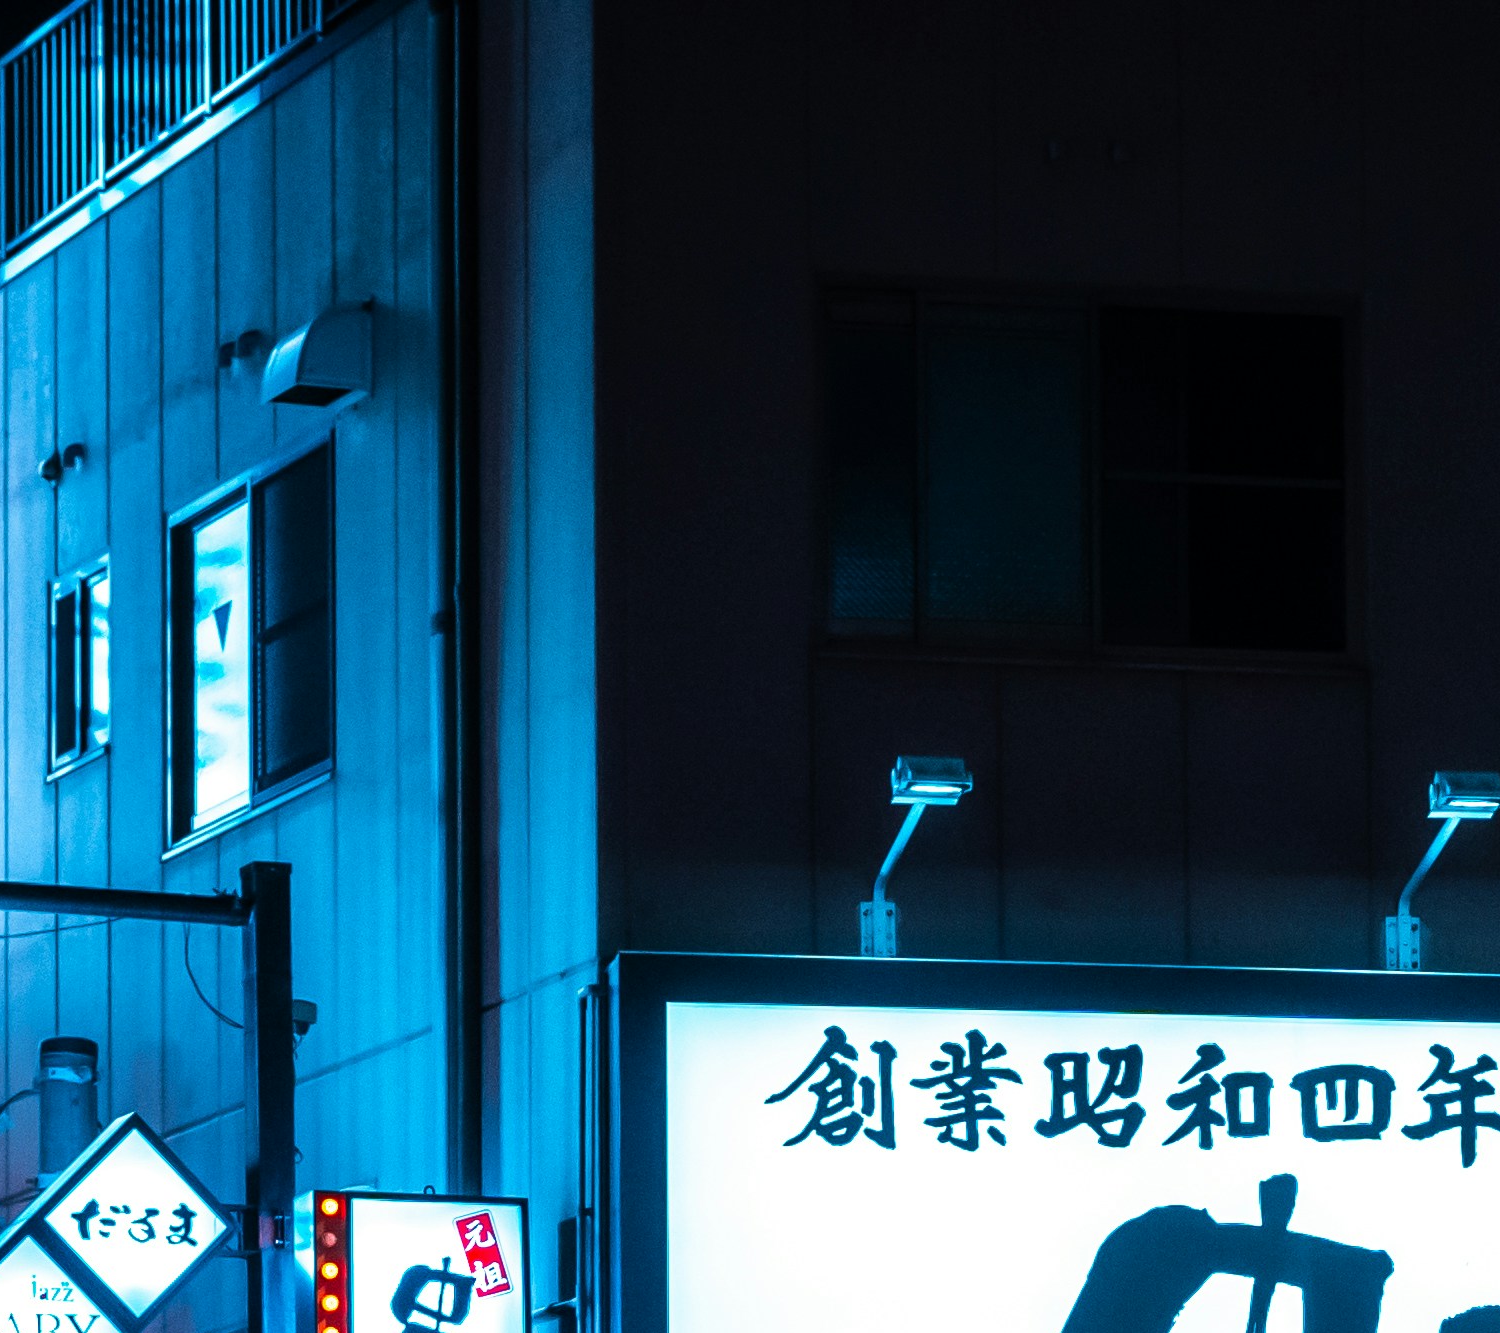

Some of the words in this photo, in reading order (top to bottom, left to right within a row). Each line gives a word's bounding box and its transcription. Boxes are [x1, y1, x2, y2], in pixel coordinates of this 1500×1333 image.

[71, 1198, 198, 1246] だるま
[464, 1220, 508, 1292] 元祖
